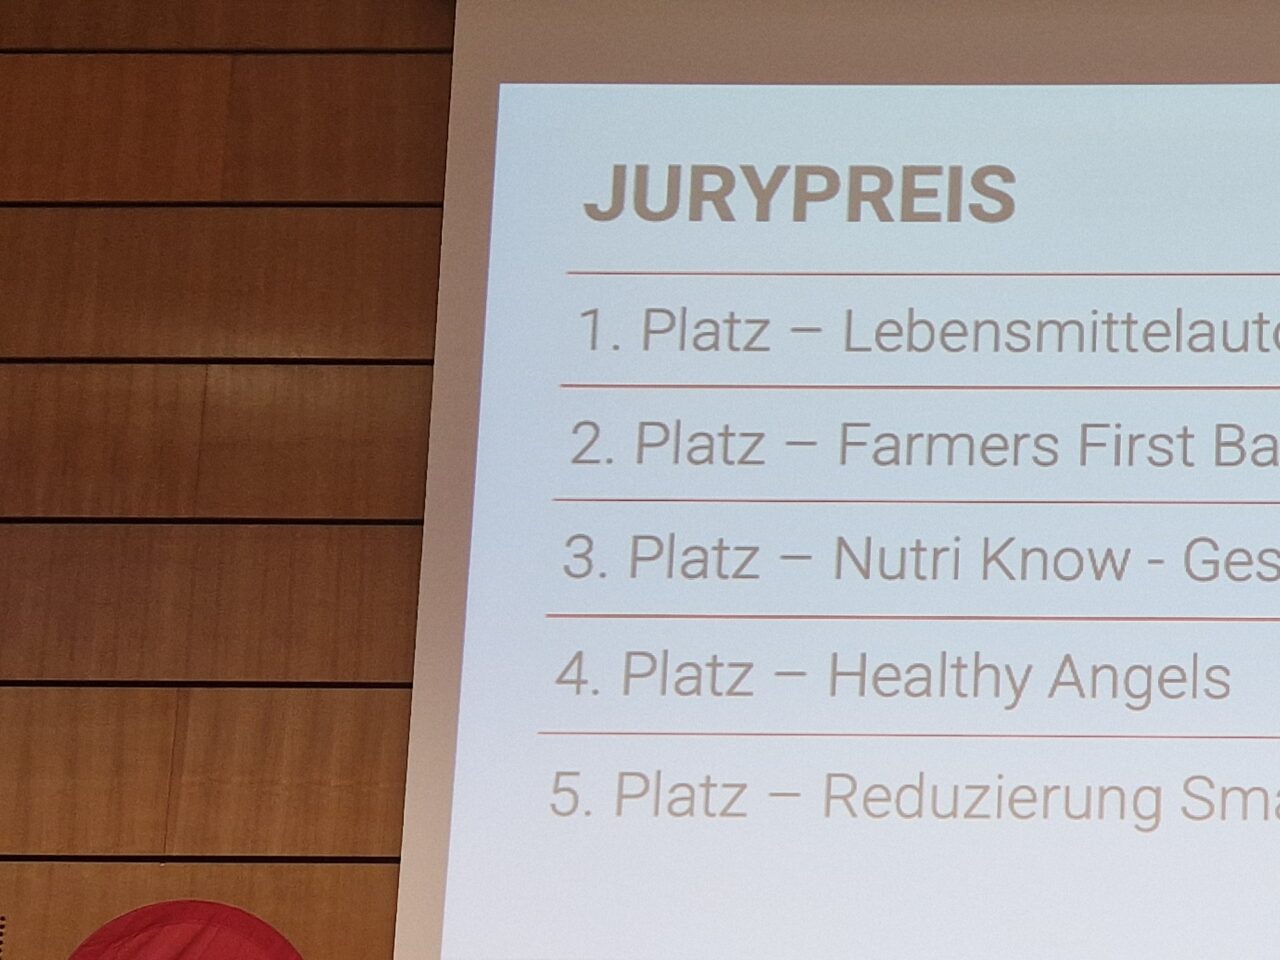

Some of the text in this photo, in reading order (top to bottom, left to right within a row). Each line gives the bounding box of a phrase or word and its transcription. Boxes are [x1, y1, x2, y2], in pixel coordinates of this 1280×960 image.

[584, 165, 1016, 223] JURYPREIS
[581, 308, 620, 352] 1.
[644, 307, 771, 352] Platz
[571, 420, 614, 465] 2.
[637, 419, 766, 466] Platz
[840, 422, 1059, 468] Farmers
[1080, 423, 1195, 468] First
[564, 534, 607, 579] 3.
[631, 533, 760, 581] Platz
[836, 536, 961, 581] Nutri
[983, 537, 1132, 582] Know
[555, 651, 600, 696] 4.
[624, 649, 754, 697] Platz
[831, 651, 1033, 711] Healthy
[1048, 653, 1231, 712] Angels
[551, 772, 592, 817] 5.
[616, 770, 748, 818] Platz
[825, 772, 1162, 833] Reduzierung
